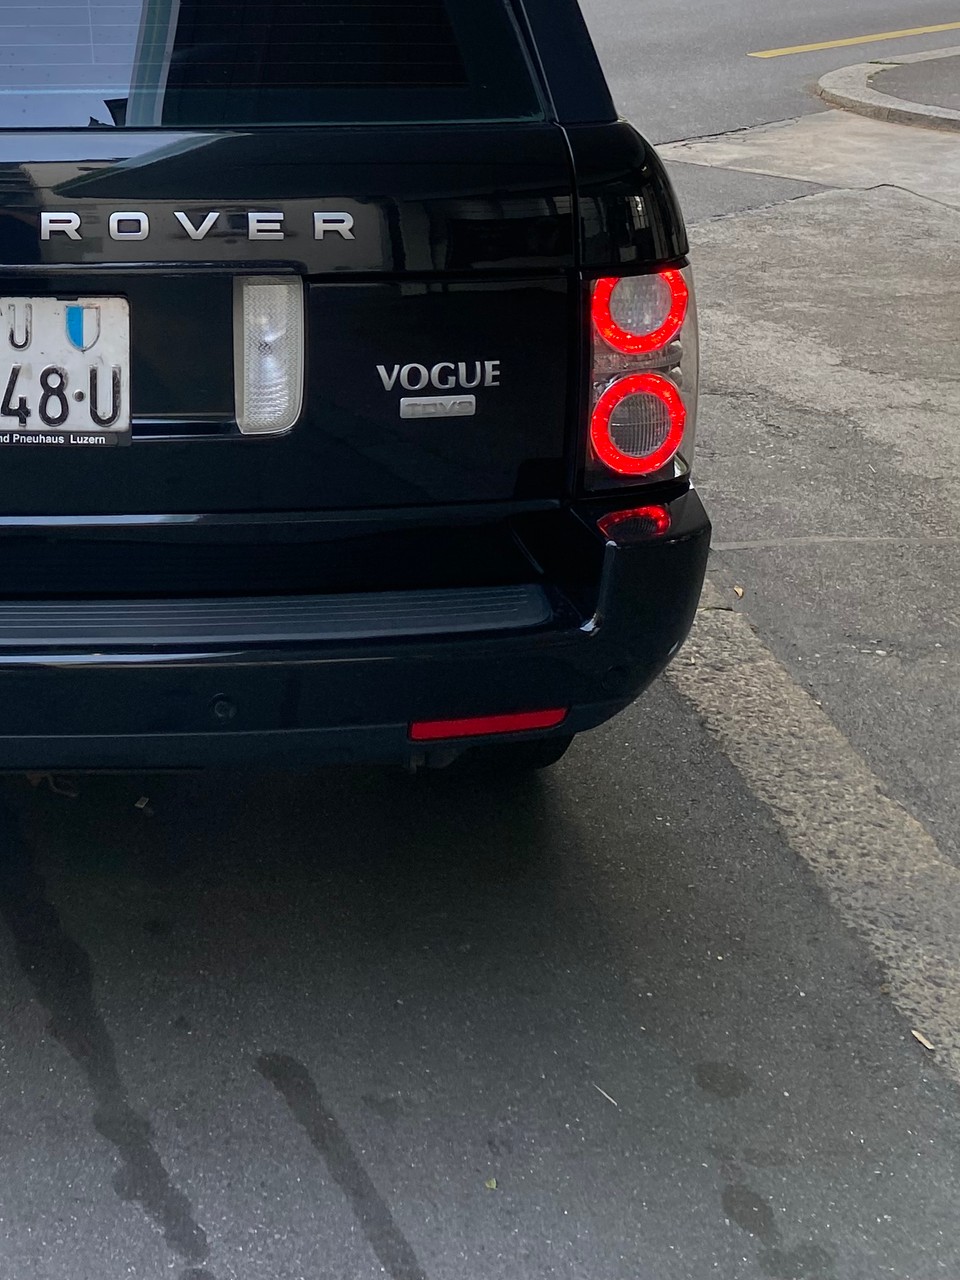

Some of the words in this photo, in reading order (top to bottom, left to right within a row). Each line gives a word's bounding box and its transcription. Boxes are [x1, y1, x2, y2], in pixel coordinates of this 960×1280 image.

[40, 211, 356, 241] ROVER
[376, 360, 501, 391] VOGUE
[12, 434, 65, 444] Pneuhaus
[69, 434, 106, 445] Luzern
